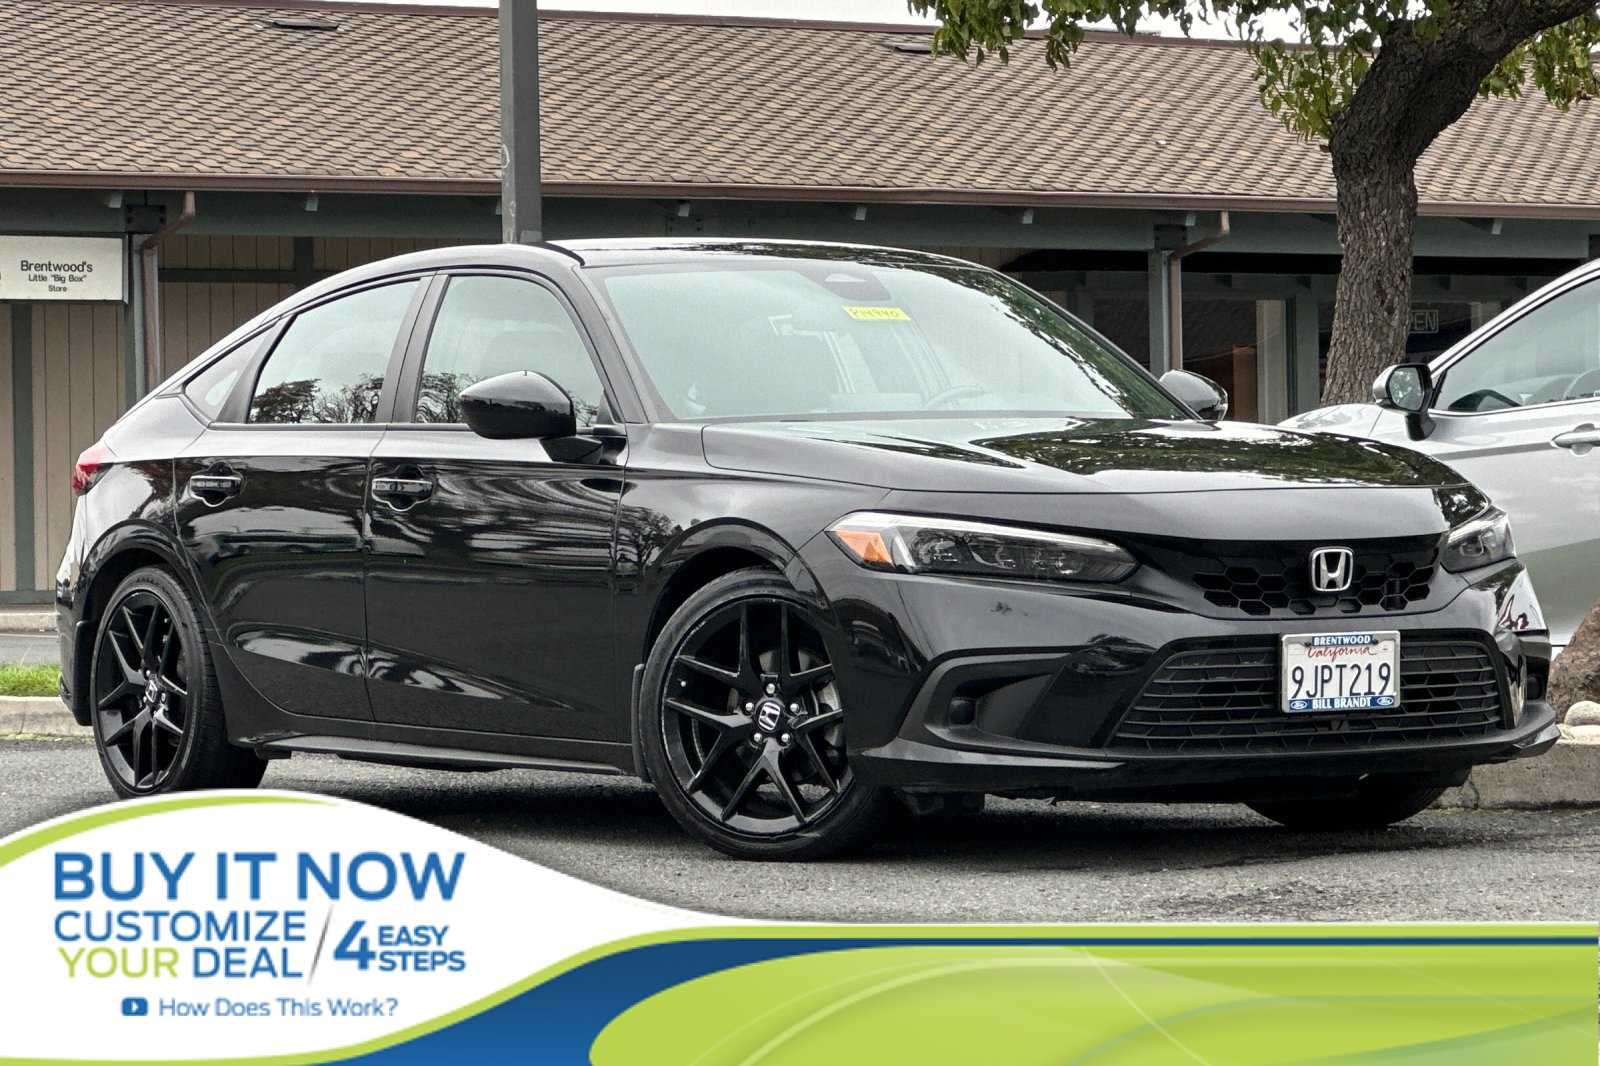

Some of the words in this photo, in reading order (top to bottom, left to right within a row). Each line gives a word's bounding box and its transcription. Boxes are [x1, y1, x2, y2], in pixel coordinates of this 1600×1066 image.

[20, 260, 93, 273] Brentwood's
[28, 274, 48, 282] Little
[48, 285, 68, 293] Store
[1313, 635, 1371, 646] BRENTWOOD
[1307, 646, 1376, 662] California
[1291, 662, 1391, 699] 9JPT219
[1312, 698, 1332, 709] BILL
[1334, 696, 1372, 708] BRANDT
